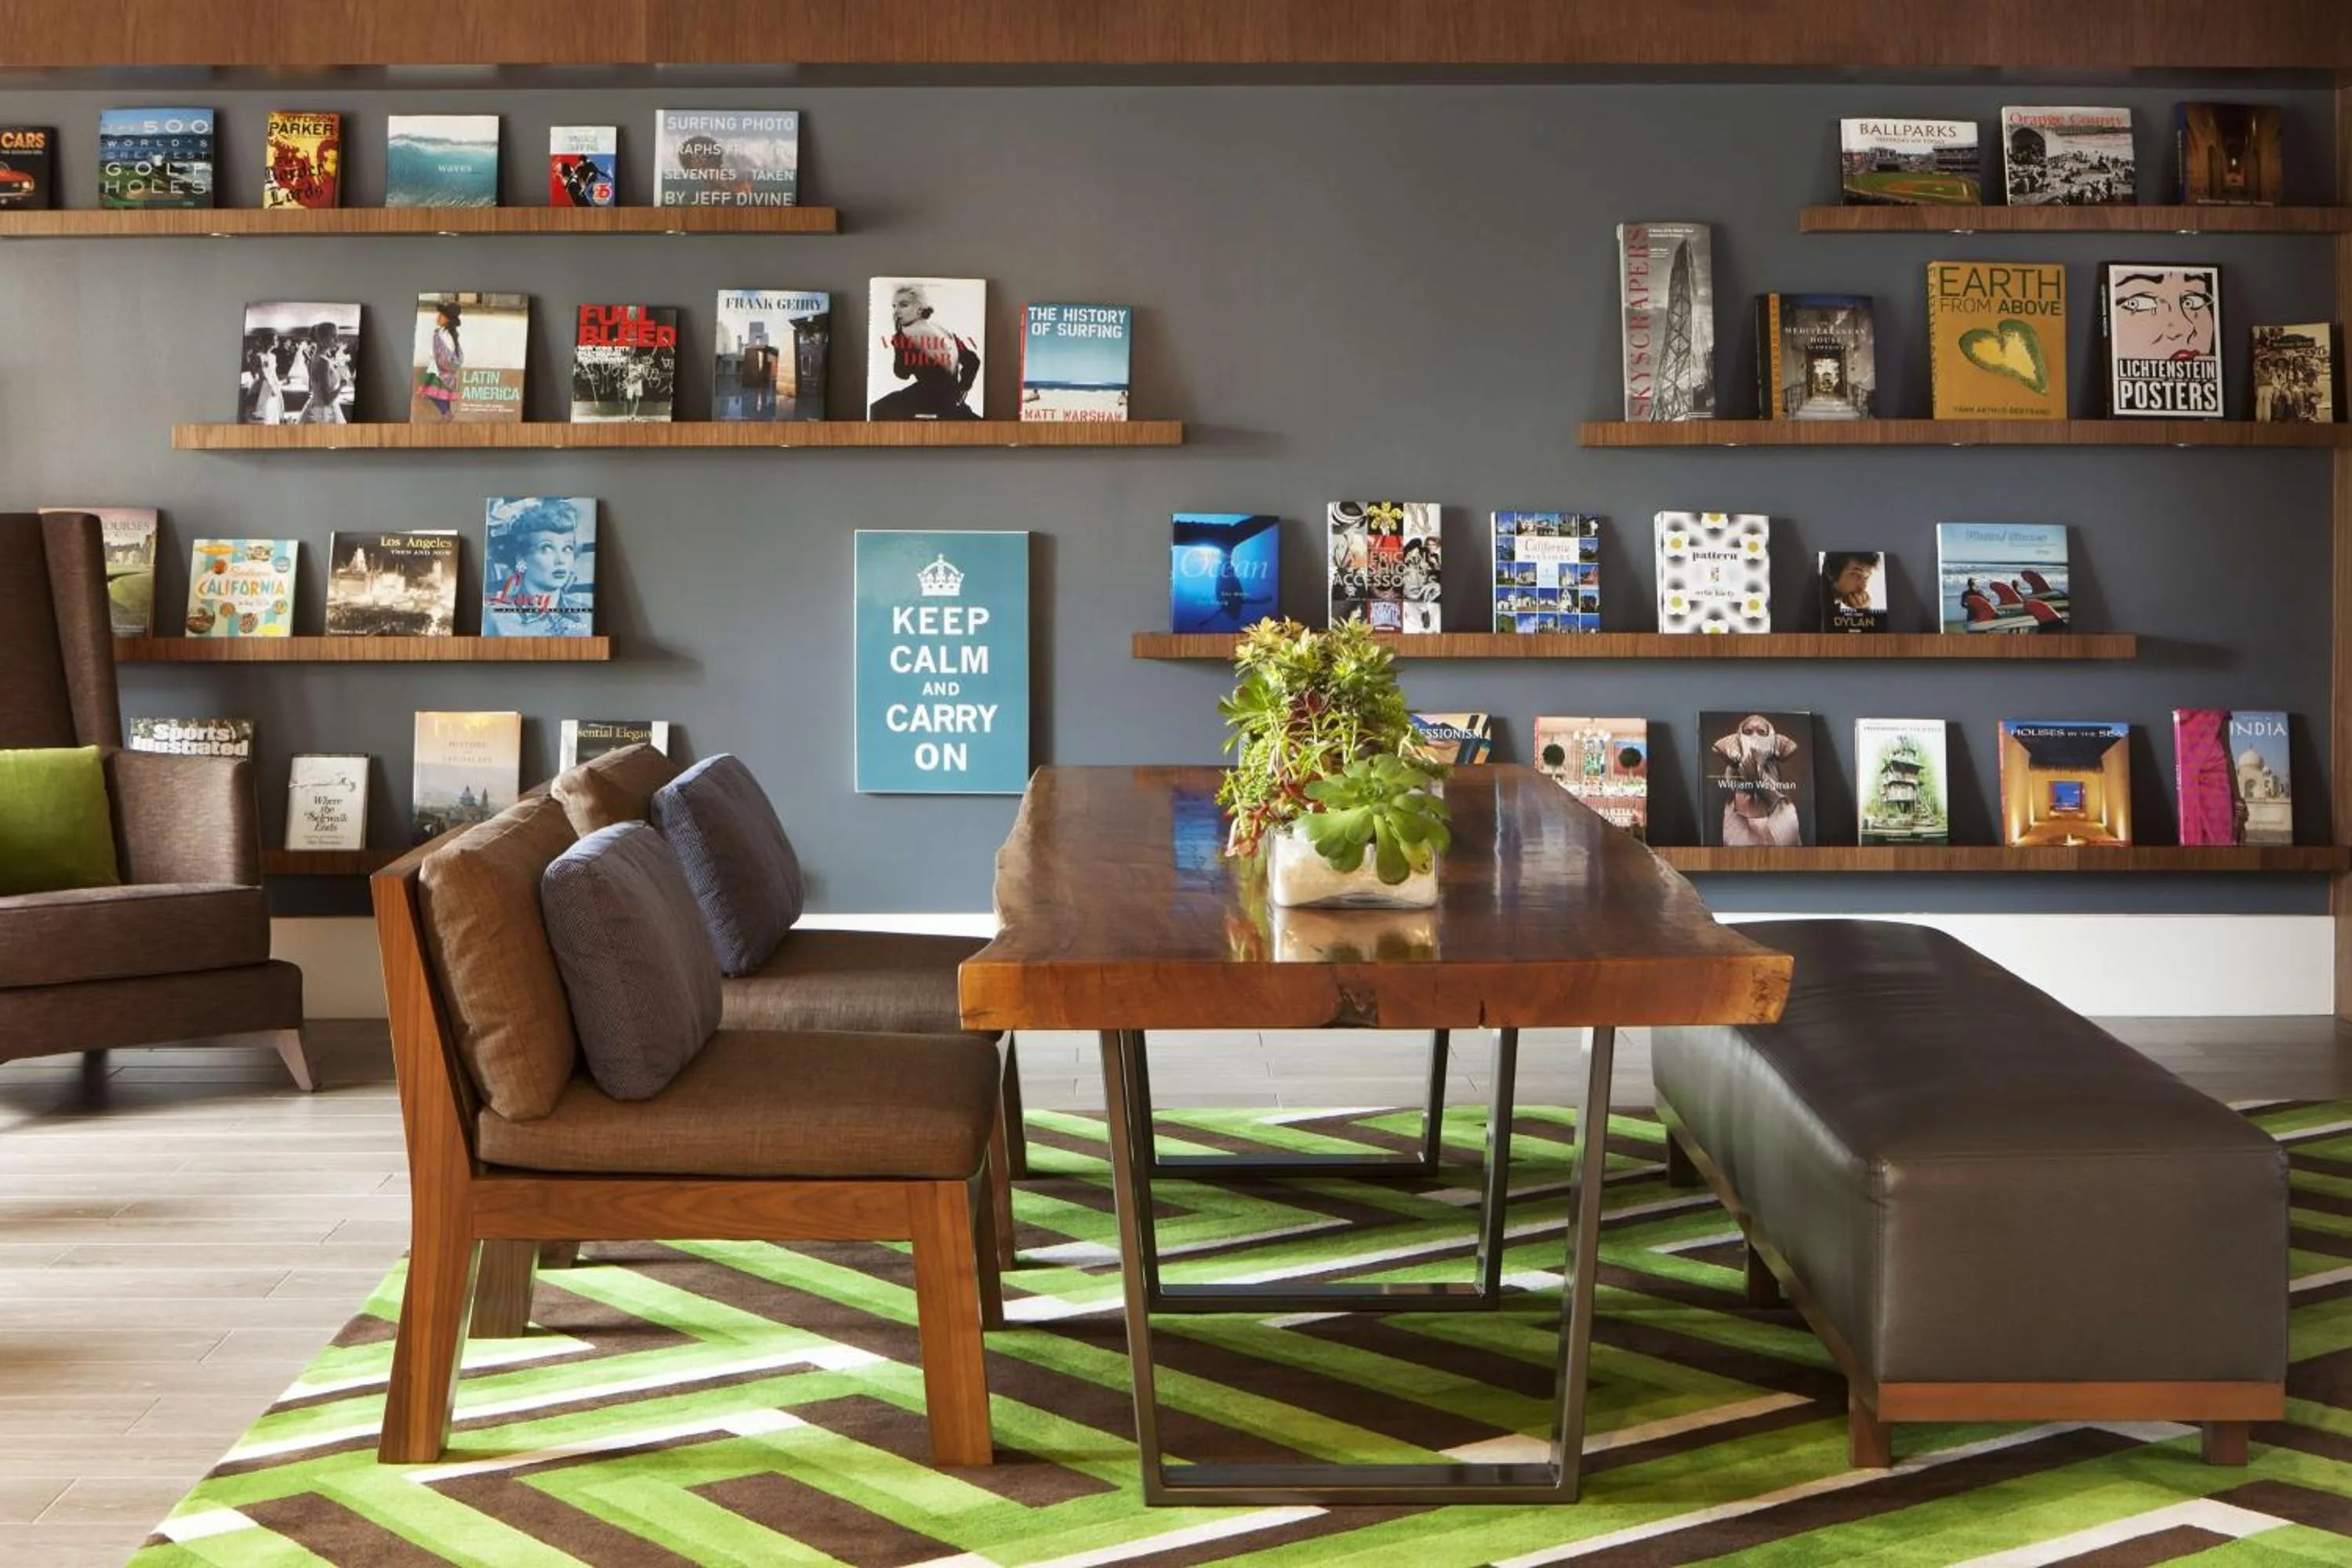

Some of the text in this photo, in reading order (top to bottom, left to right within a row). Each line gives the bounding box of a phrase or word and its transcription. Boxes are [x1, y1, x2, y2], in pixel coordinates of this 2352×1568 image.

[143, 119, 209, 134] 500
[269, 122, 333, 136] PARKER
[667, 116, 794, 132] SURFING PHOTO
[1860, 123, 1957, 138] BALLPARKS
[1, 131, 45, 149] CARS
[107, 138, 208, 147] WORLD'S
[668, 143, 722, 155] RAPHS
[106, 161, 212, 176] GOLF
[665, 168, 794, 181] SEVENTIES TAKEN
[104, 179, 207, 195] HOLES
[666, 191, 793, 207] BY JEFF DIVINE
[1940, 266, 2062, 299] EARTH
[726, 297, 822, 311] FRANK GEHRY
[1939, 296, 2062, 317] FROM ABOVE
[579, 302, 655, 326] FULL
[1028, 307, 1127, 325] THE HISTORY
[1627, 226, 1652, 417] SKYSCRAPERS
[579, 325, 677, 348] BLEED
[1031, 322, 1123, 339] OF SURFING
[1809, 336, 1841, 344] HOUSE
[2118, 358, 2216, 379] LICHTENSTEIN
[462, 371, 500, 383] LATIN
[461, 387, 521, 401] AMERICA
[2121, 381, 2217, 411] POSTERS
[1025, 408, 1124, 422] MATT WARSHAW
[380, 536, 452, 550] Los Angeles
[1693, 551, 1738, 561] pattern
[198, 579, 285, 597] CALIFORNIA
[892, 606, 990, 636] KEEP
[1834, 617, 1875, 626] DYLAN
[890, 644, 989, 674] CALM
[922, 681, 960, 696] AND
[886, 703, 999, 734] CARRY
[153, 724, 237, 742] Sports
[1418, 728, 1483, 739] ESSIONISM
[2011, 728, 2065, 737] HOUSES
[2229, 720, 2288, 737] INDIA
[914, 742, 967, 771] ON
[1718, 779, 1797, 791] William Wegman
